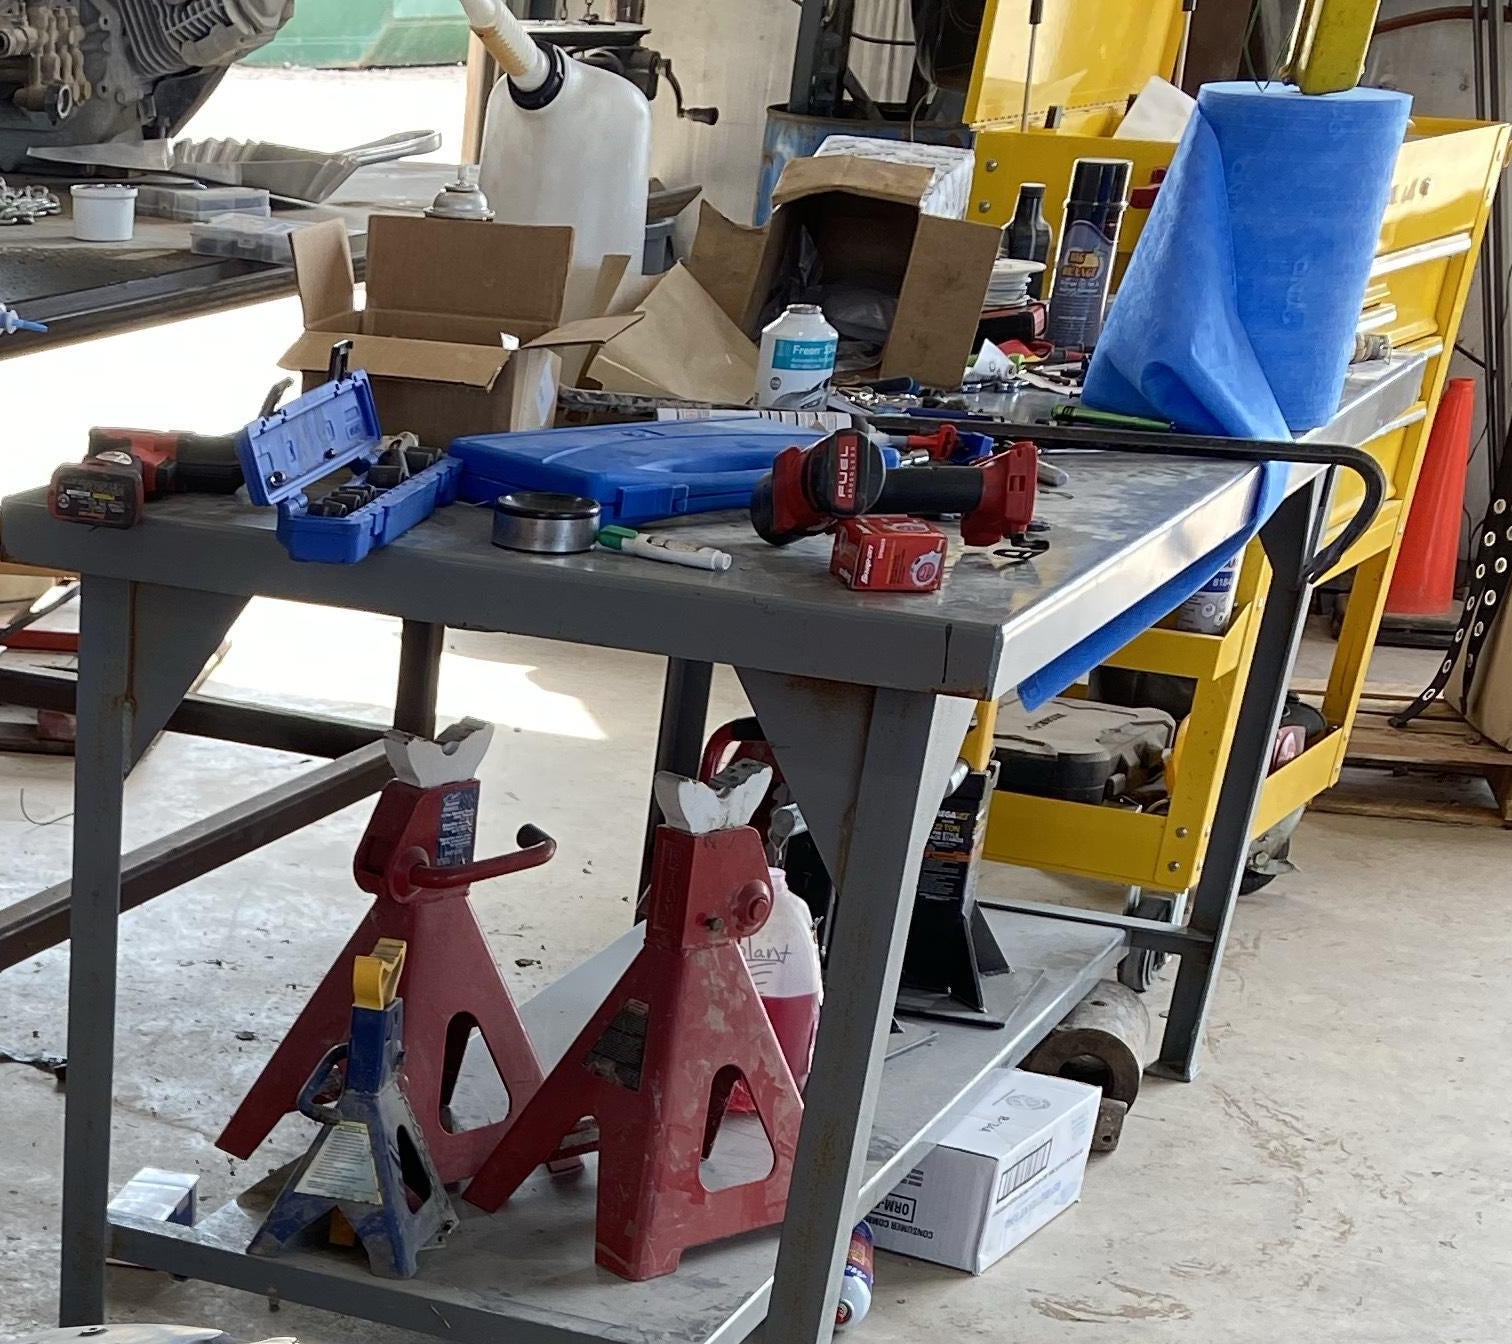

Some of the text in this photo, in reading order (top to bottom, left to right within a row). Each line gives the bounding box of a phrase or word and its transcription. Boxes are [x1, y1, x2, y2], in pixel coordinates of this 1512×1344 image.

[793, 344, 821, 355] Freon
[838, 446, 849, 498] FUEL
[891, 1221, 934, 1239] CONSUMER
